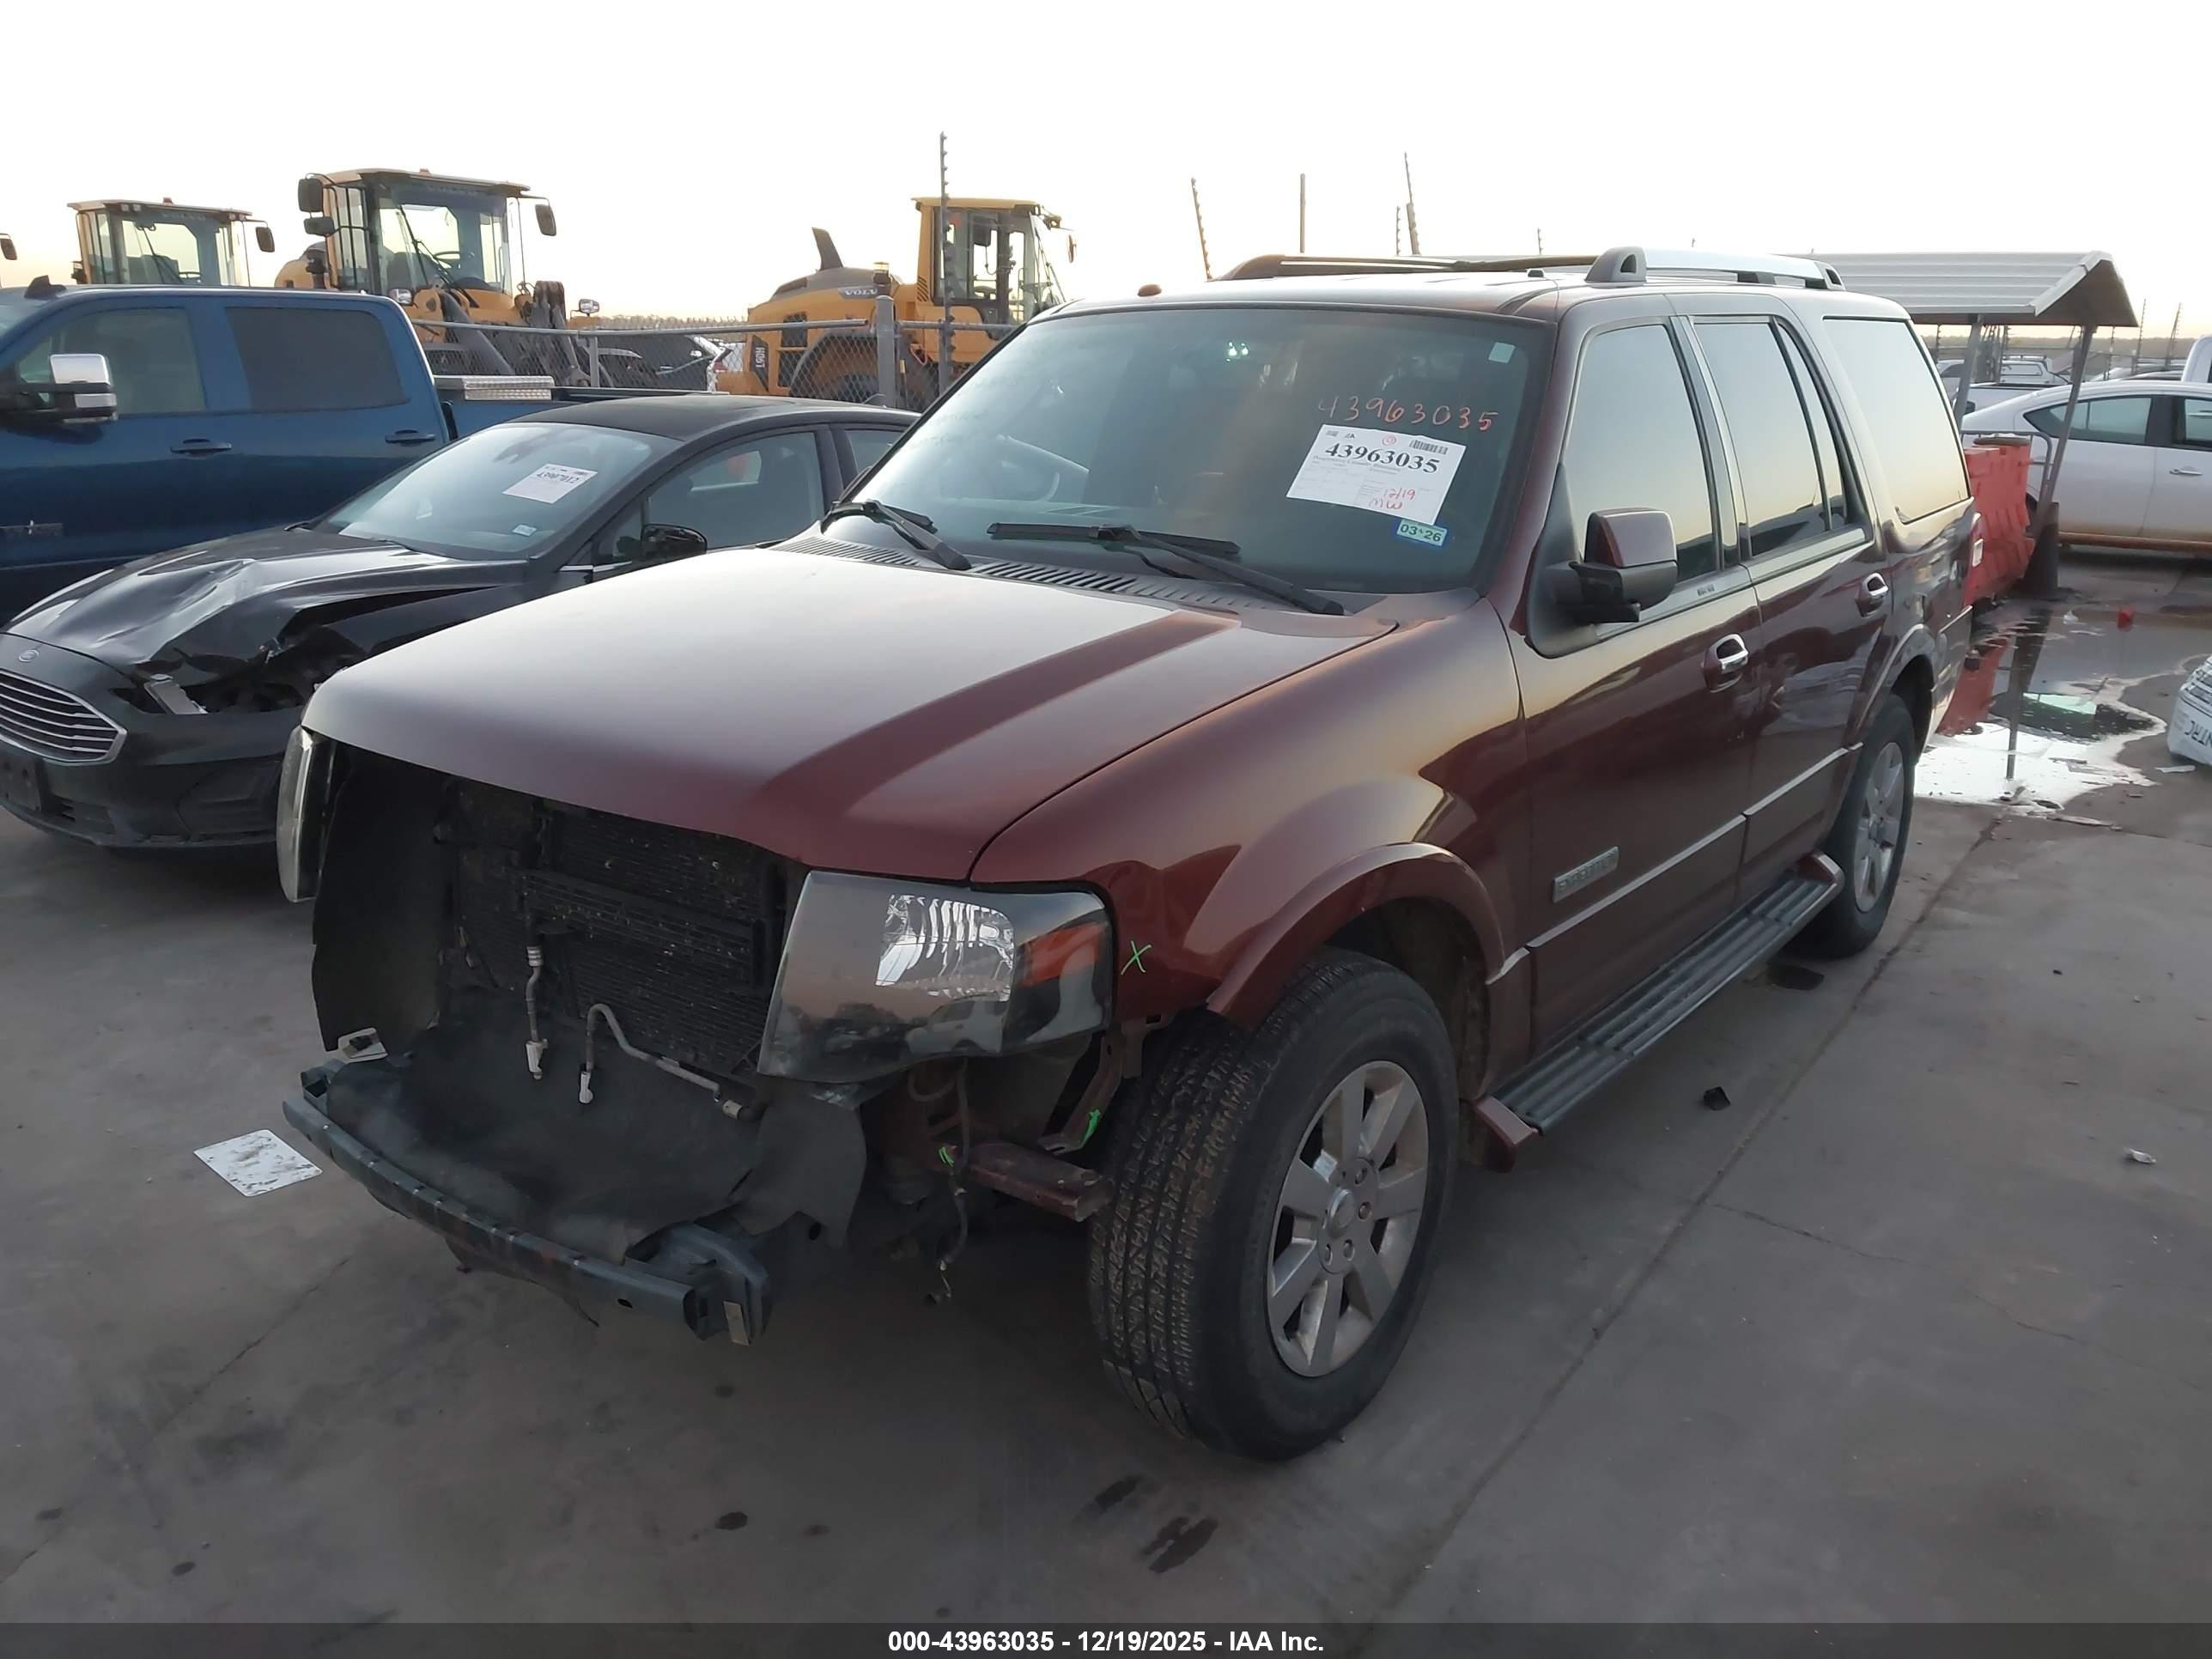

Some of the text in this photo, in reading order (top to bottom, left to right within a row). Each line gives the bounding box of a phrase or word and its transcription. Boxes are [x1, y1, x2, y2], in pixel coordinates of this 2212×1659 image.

[845, 288, 878, 296] VOLV
[1318, 396, 1499, 430] 43963035
[1325, 442, 1441, 474] 43963035
[1384, 489, 1416, 501] 12/19
